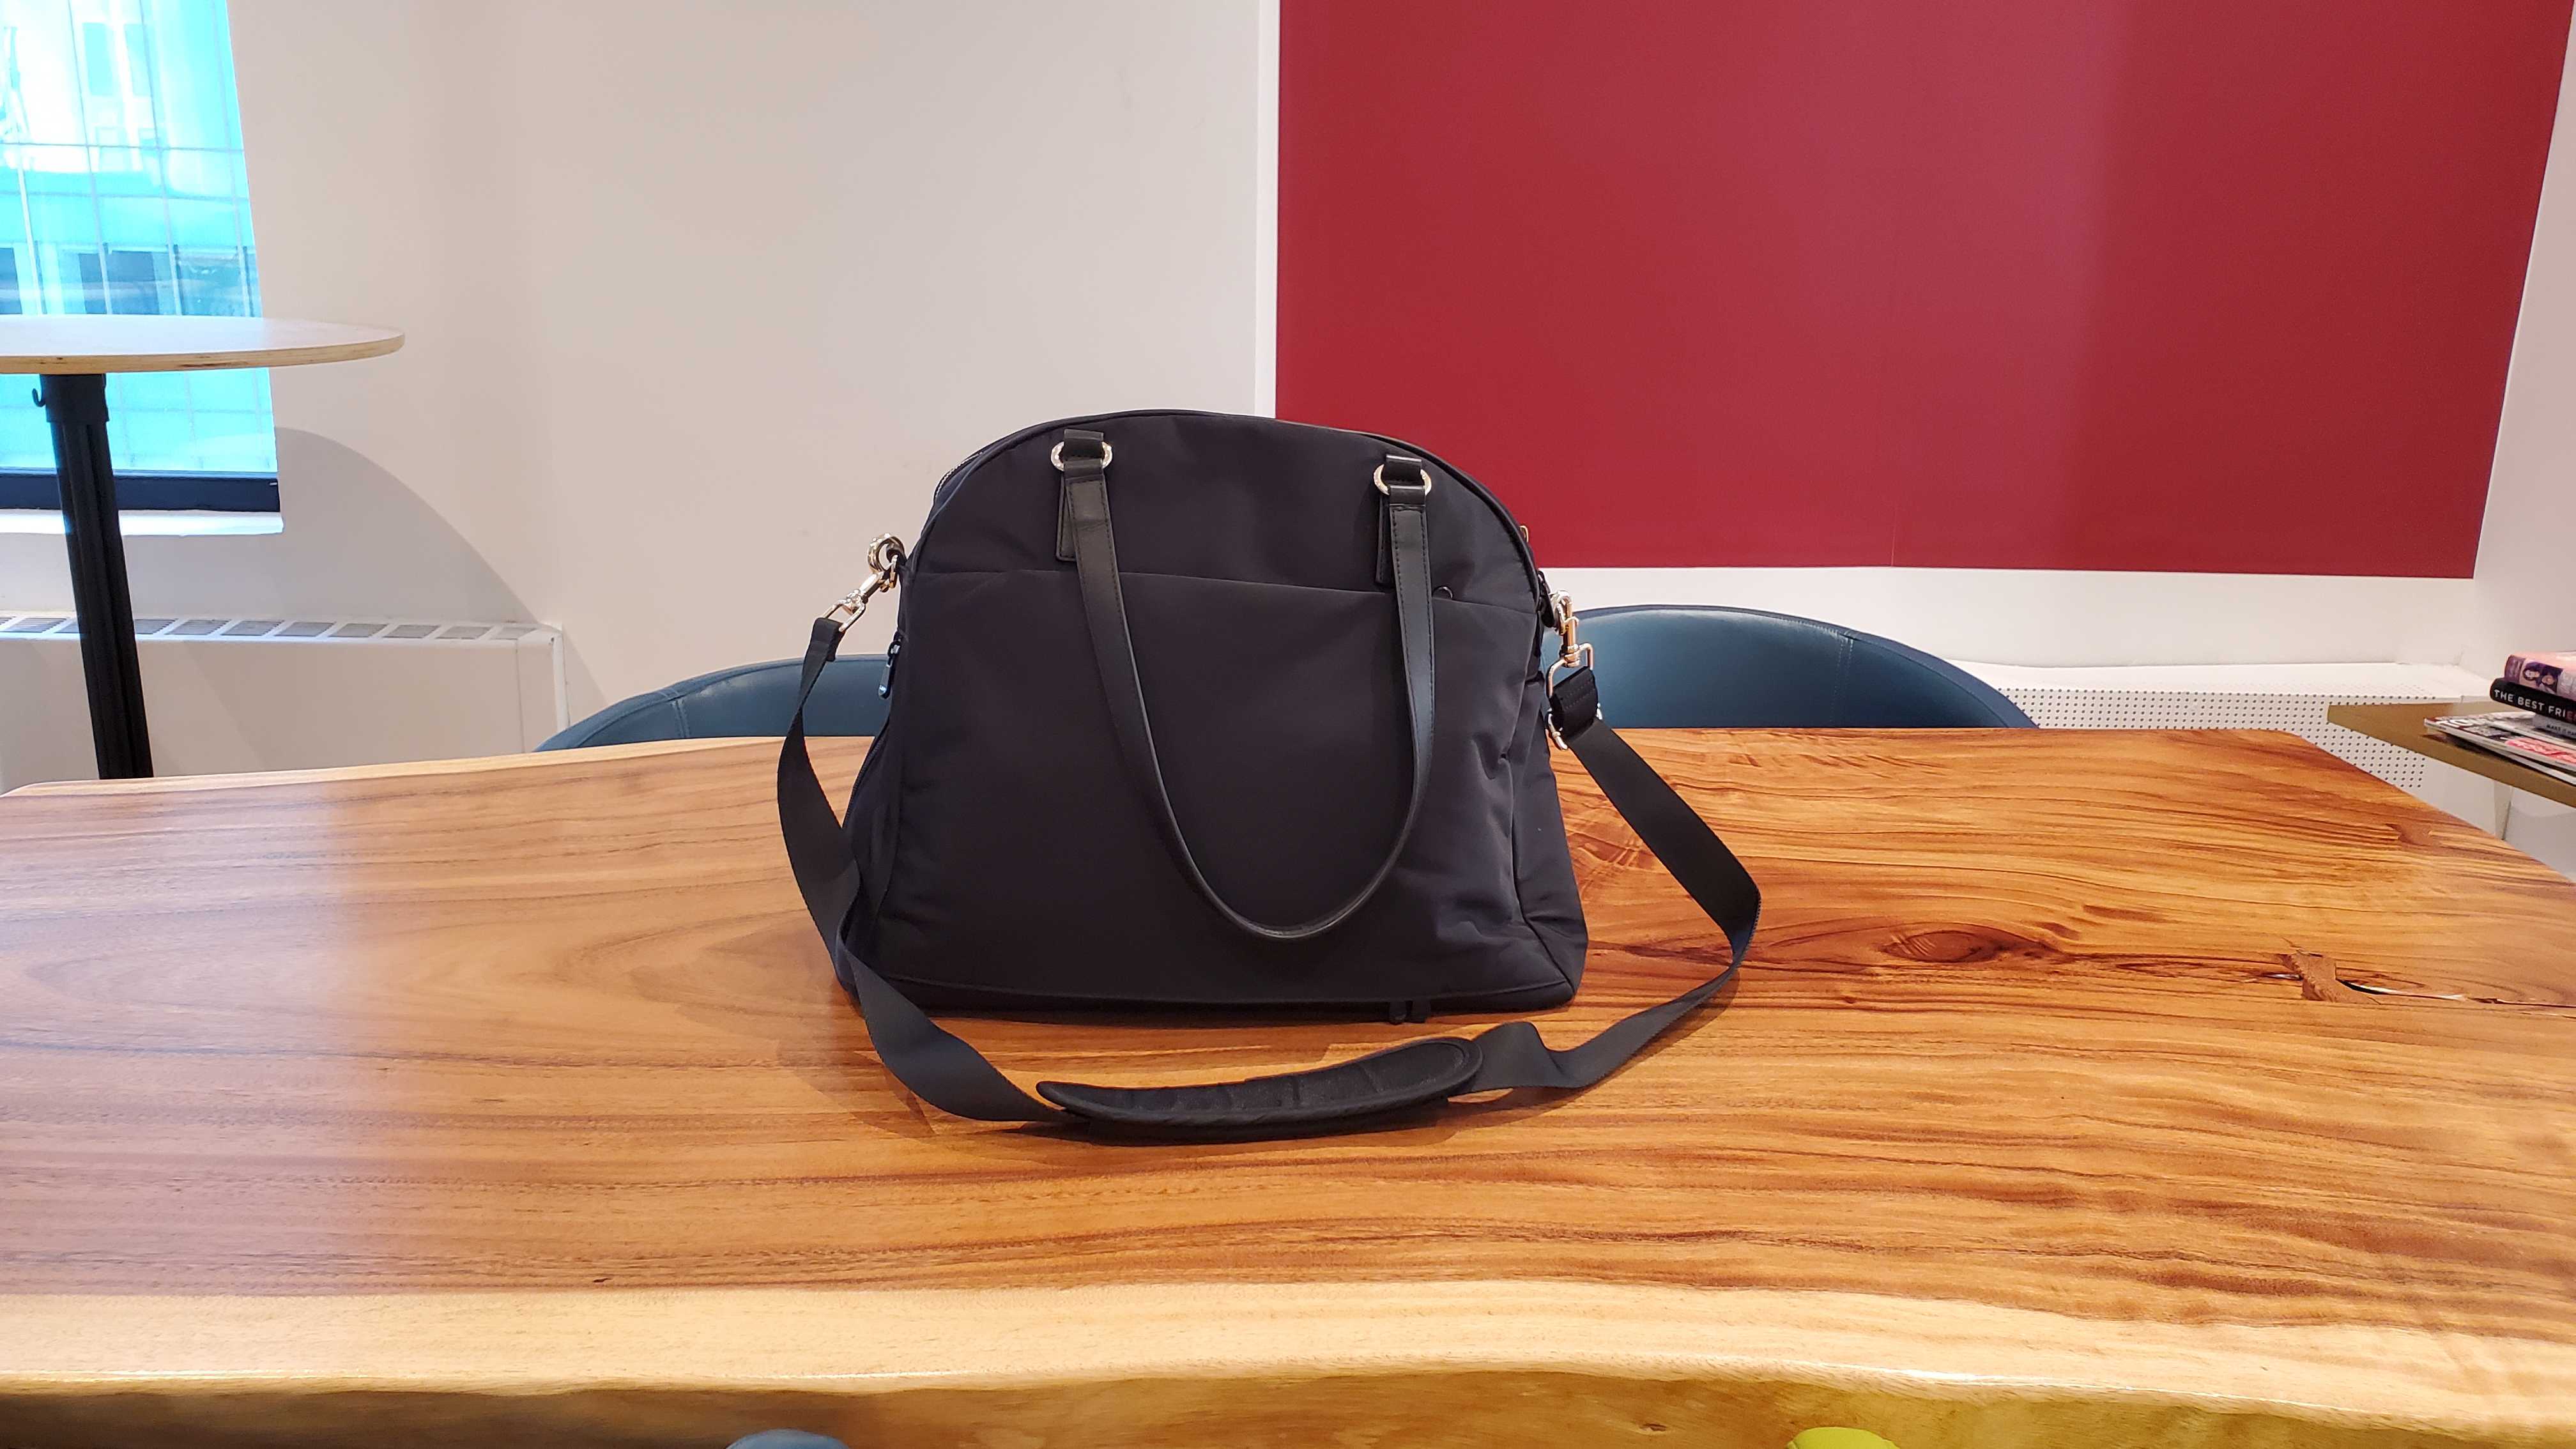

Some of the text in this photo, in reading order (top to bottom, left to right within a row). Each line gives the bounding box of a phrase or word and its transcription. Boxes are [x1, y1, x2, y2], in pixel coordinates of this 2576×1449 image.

[2494, 689, 2576, 722] THE BEST FRIE
